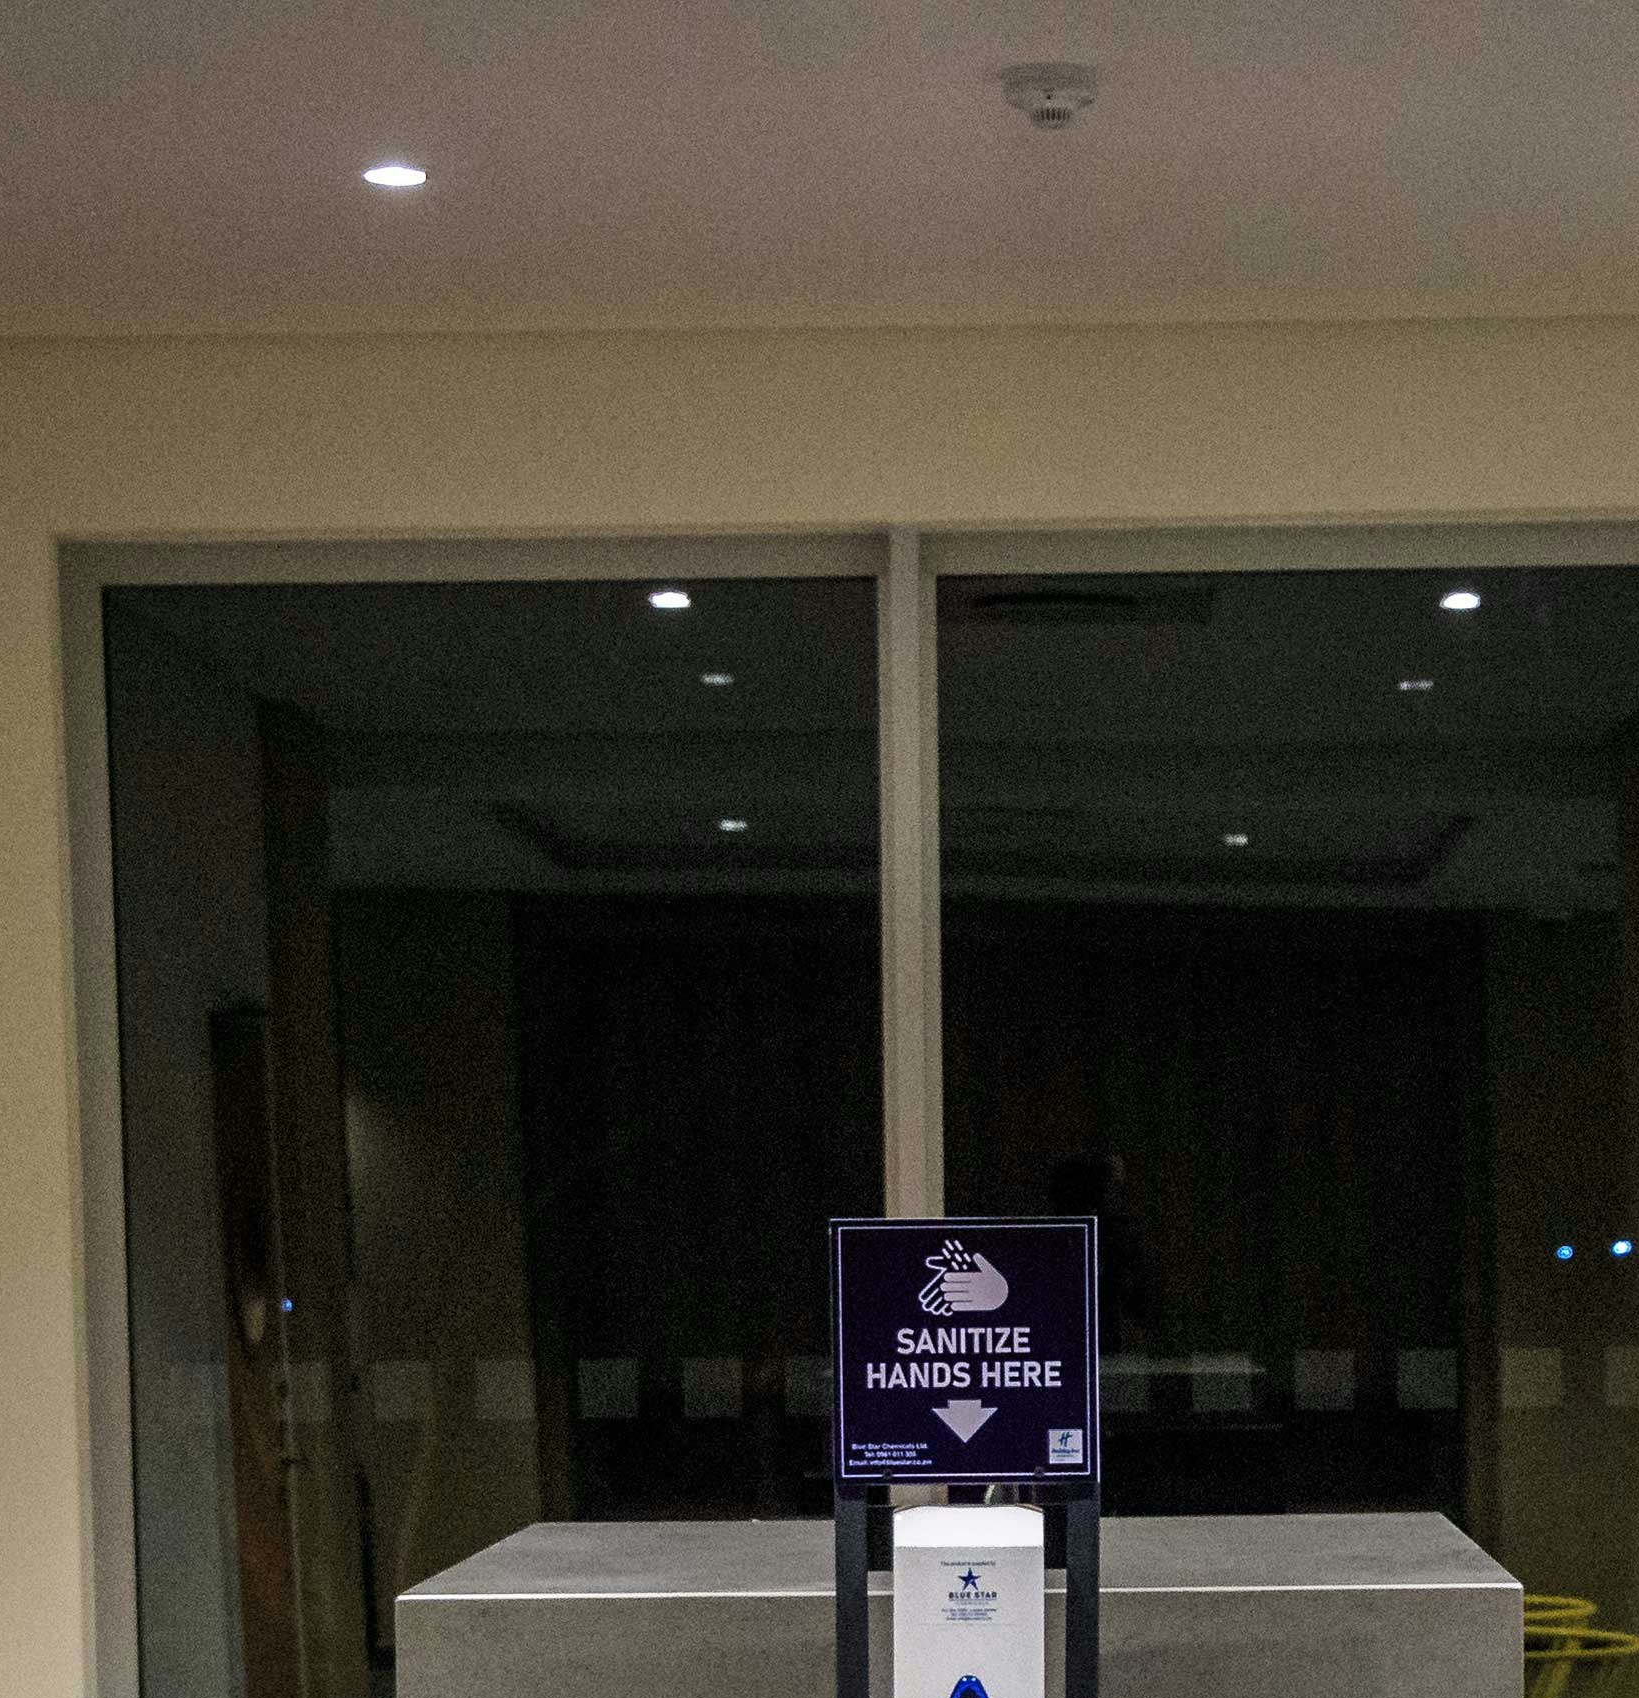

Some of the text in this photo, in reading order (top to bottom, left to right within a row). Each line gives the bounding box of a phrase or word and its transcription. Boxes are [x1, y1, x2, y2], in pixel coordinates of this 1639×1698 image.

[897, 1327, 1031, 1355] SANITIZE
[866, 1360, 1062, 1389] HANDS HERE
